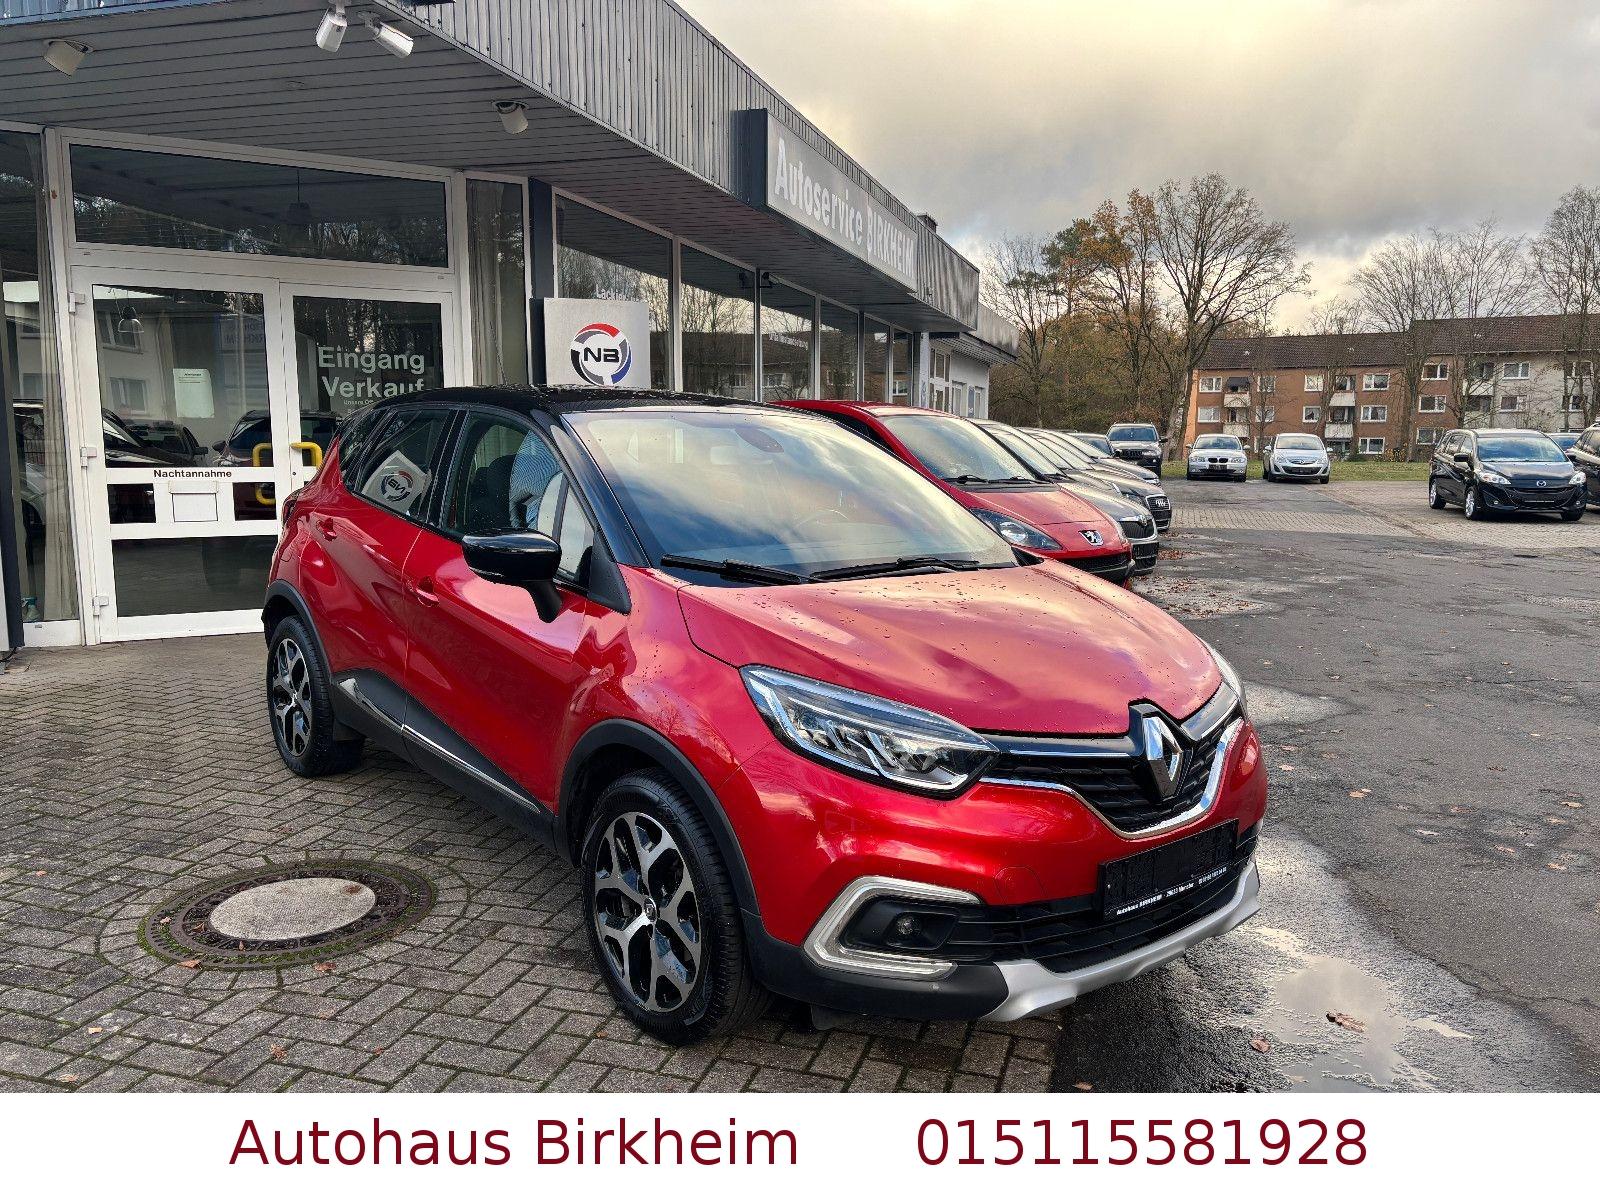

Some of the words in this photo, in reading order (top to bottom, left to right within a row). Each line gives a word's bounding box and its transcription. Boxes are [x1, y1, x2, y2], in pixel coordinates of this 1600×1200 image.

[774, 137, 863, 246] Autoservice
[867, 205, 914, 279] BIRKHEIM
[318, 345, 425, 375] Eingang
[583, 346, 619, 363] NB
[321, 376, 424, 398] Verkauf
[153, 469, 232, 478] Nachtannahme
[1116, 904, 1138, 915] Autohaus
